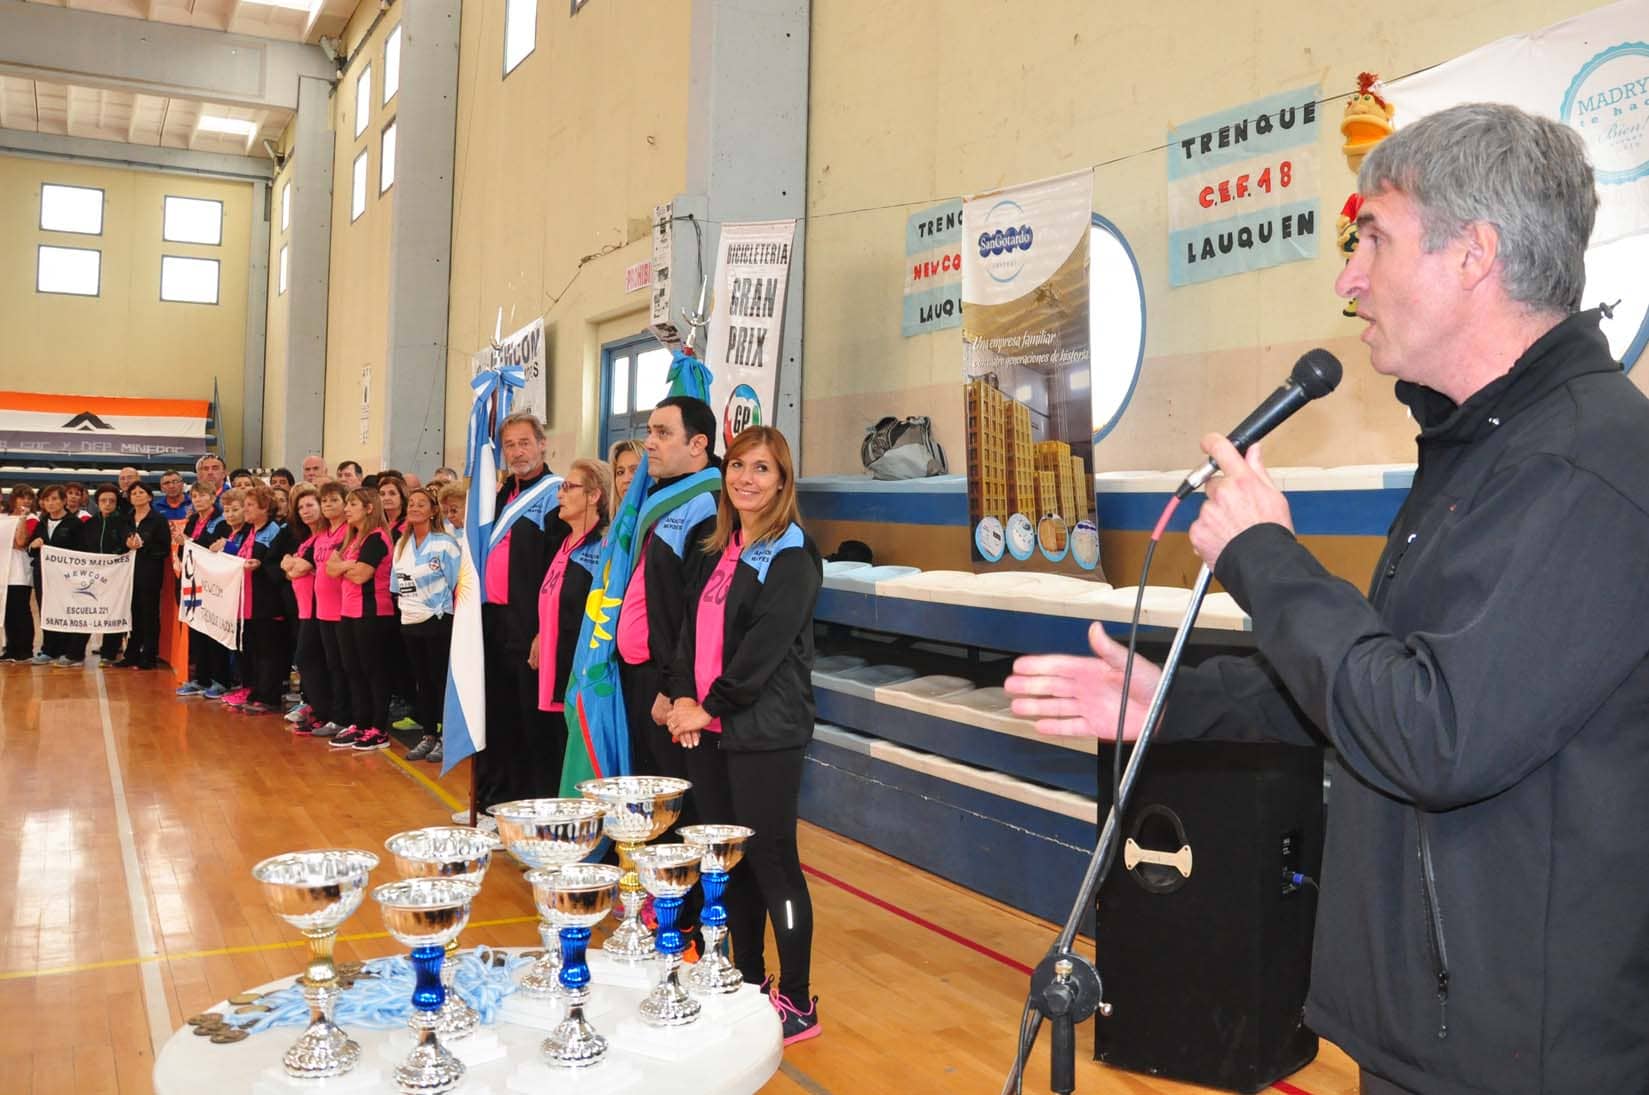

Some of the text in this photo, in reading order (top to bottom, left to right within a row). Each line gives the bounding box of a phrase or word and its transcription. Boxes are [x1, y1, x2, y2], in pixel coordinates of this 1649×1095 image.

[1182, 101, 1316, 159] TRENQUE
[1187, 210, 1314, 264] LAUQUEN
[727, 243, 788, 265] BICICLETERIA
[729, 278, 778, 318] GRAN
[726, 326, 768, 368] PRIX
[733, 405, 750, 433] GP
[45, 555, 87, 565] ADULTOS
[64, 570, 108, 584] NEWCOM
[46, 617, 69, 626] SANTA
[69, 619, 88, 628] ROSA
[93, 619, 102, 628] LA
[66, 606, 97, 615] ESCUELA
